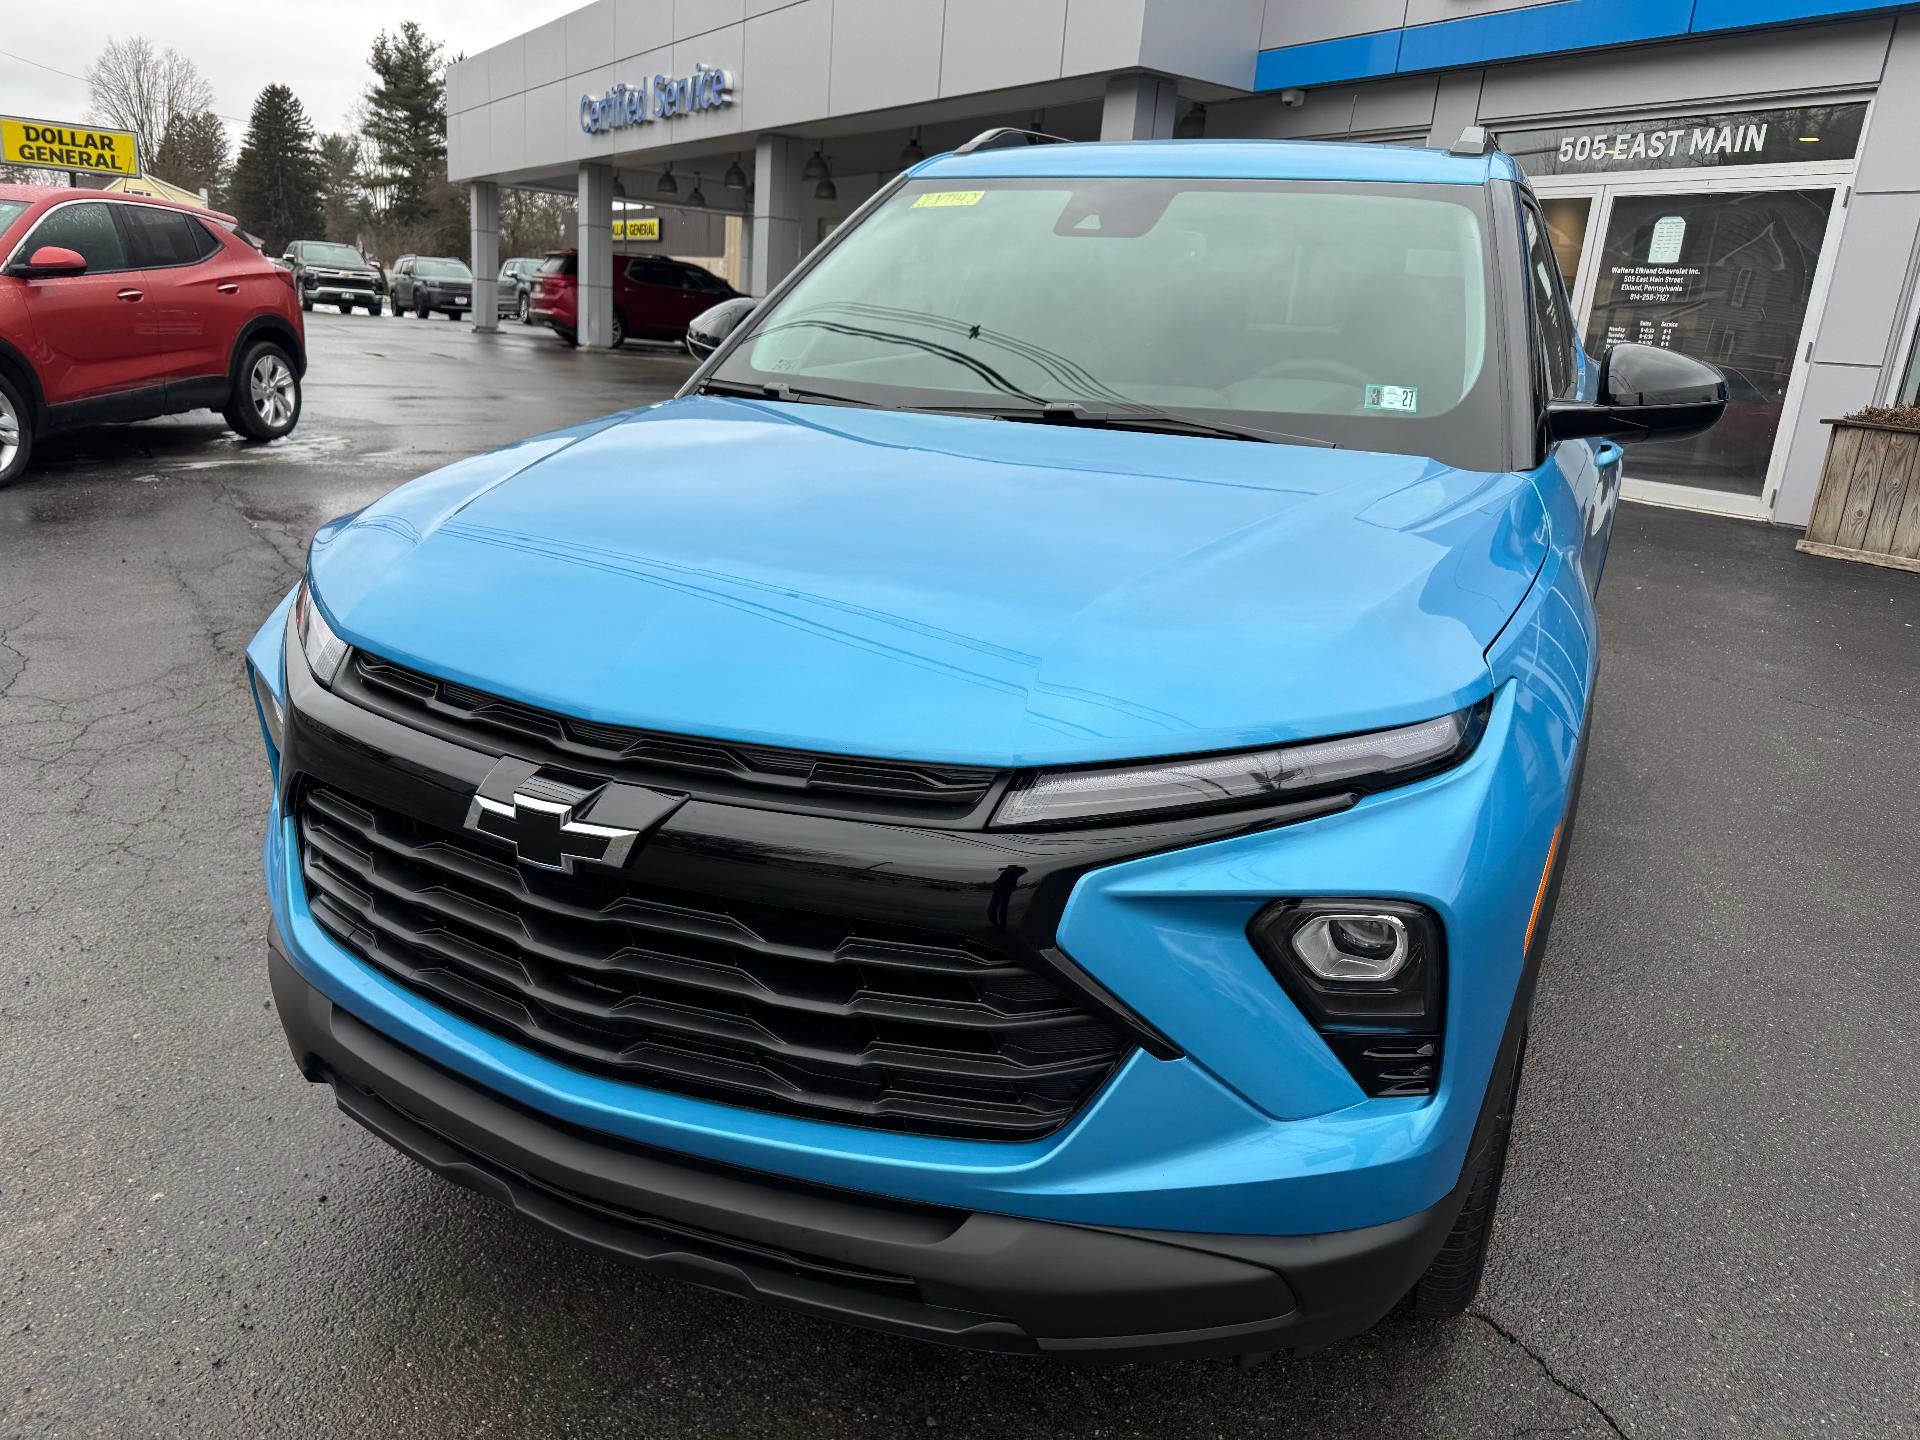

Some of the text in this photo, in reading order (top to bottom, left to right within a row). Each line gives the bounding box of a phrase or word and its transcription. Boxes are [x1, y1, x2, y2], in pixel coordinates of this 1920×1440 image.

[579, 63, 731, 134] Certified Service
[22, 125, 115, 152] DOLLAR
[1558, 123, 1768, 163] 505 EAST MAIN
[18, 144, 123, 171] GENERAL
[629, 222, 656, 236] GENERAL
[1623, 275, 1635, 283] 505
[1664, 276, 1684, 284] Street
[1635, 267, 1657, 275] Elkland
[1658, 267, 1688, 275] Chevrolet
[1643, 285, 1683, 293] Pennsylvania
[1402, 390, 1414, 409] 27
